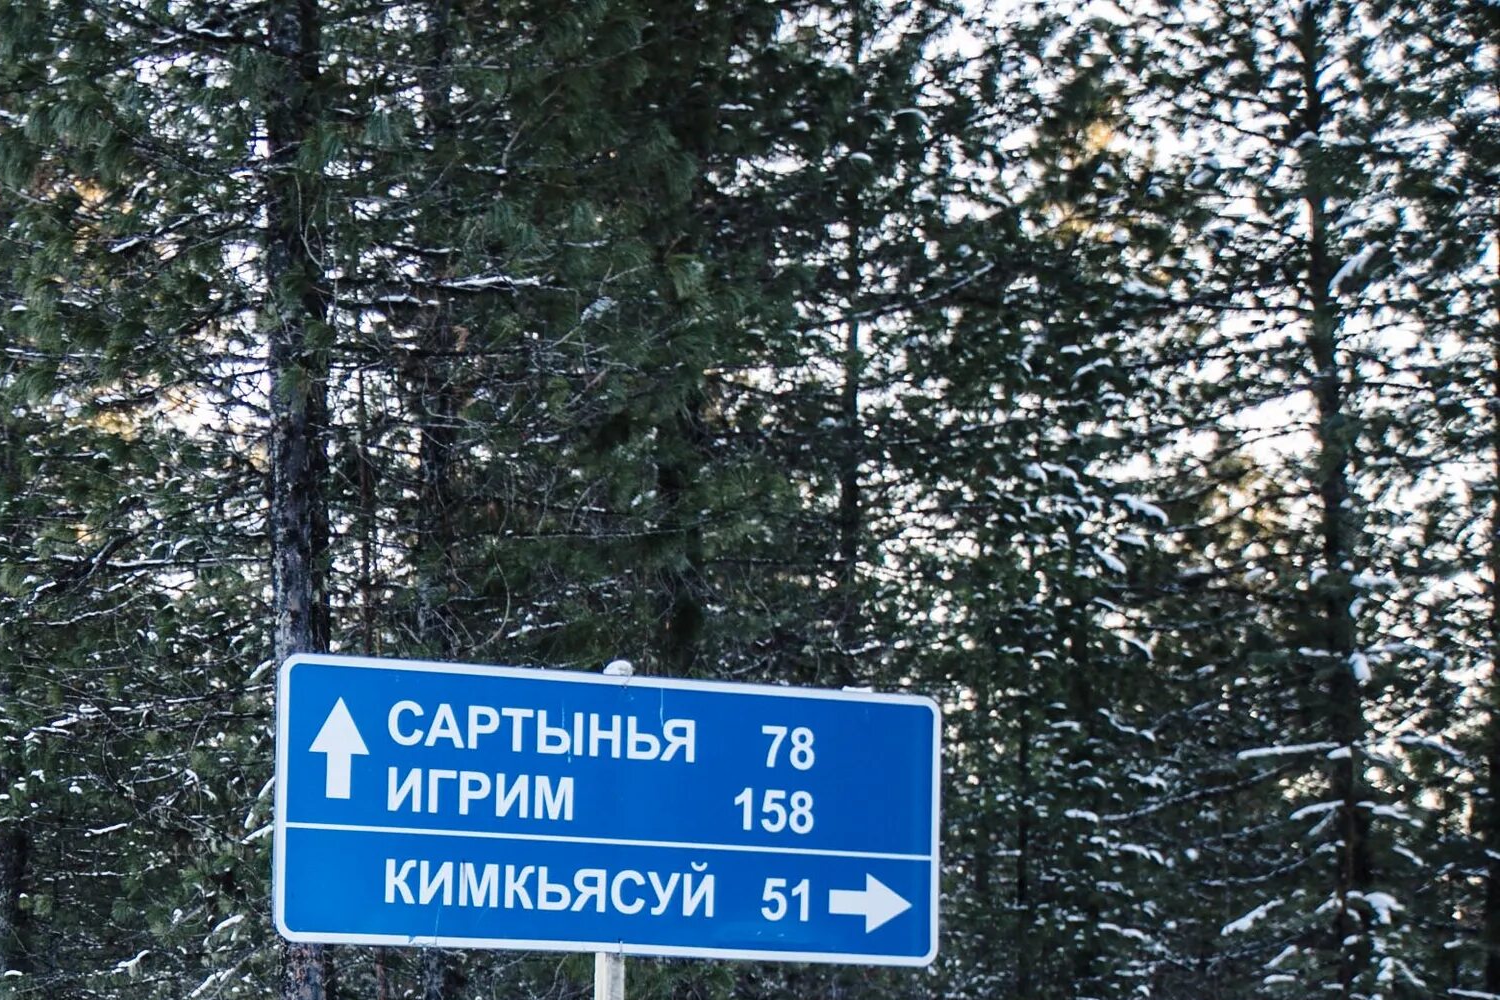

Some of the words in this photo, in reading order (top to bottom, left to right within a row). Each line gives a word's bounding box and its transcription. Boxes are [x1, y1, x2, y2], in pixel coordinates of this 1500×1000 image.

[387, 700, 697, 763] САРТЫНЬЯ
[761, 725, 816, 771] 78
[386, 766, 575, 821] ИГРИМ
[733, 787, 815, 835] 158
[384, 858, 716, 919] КИМКЬЯСУЙ
[760, 878, 810, 922] 51
